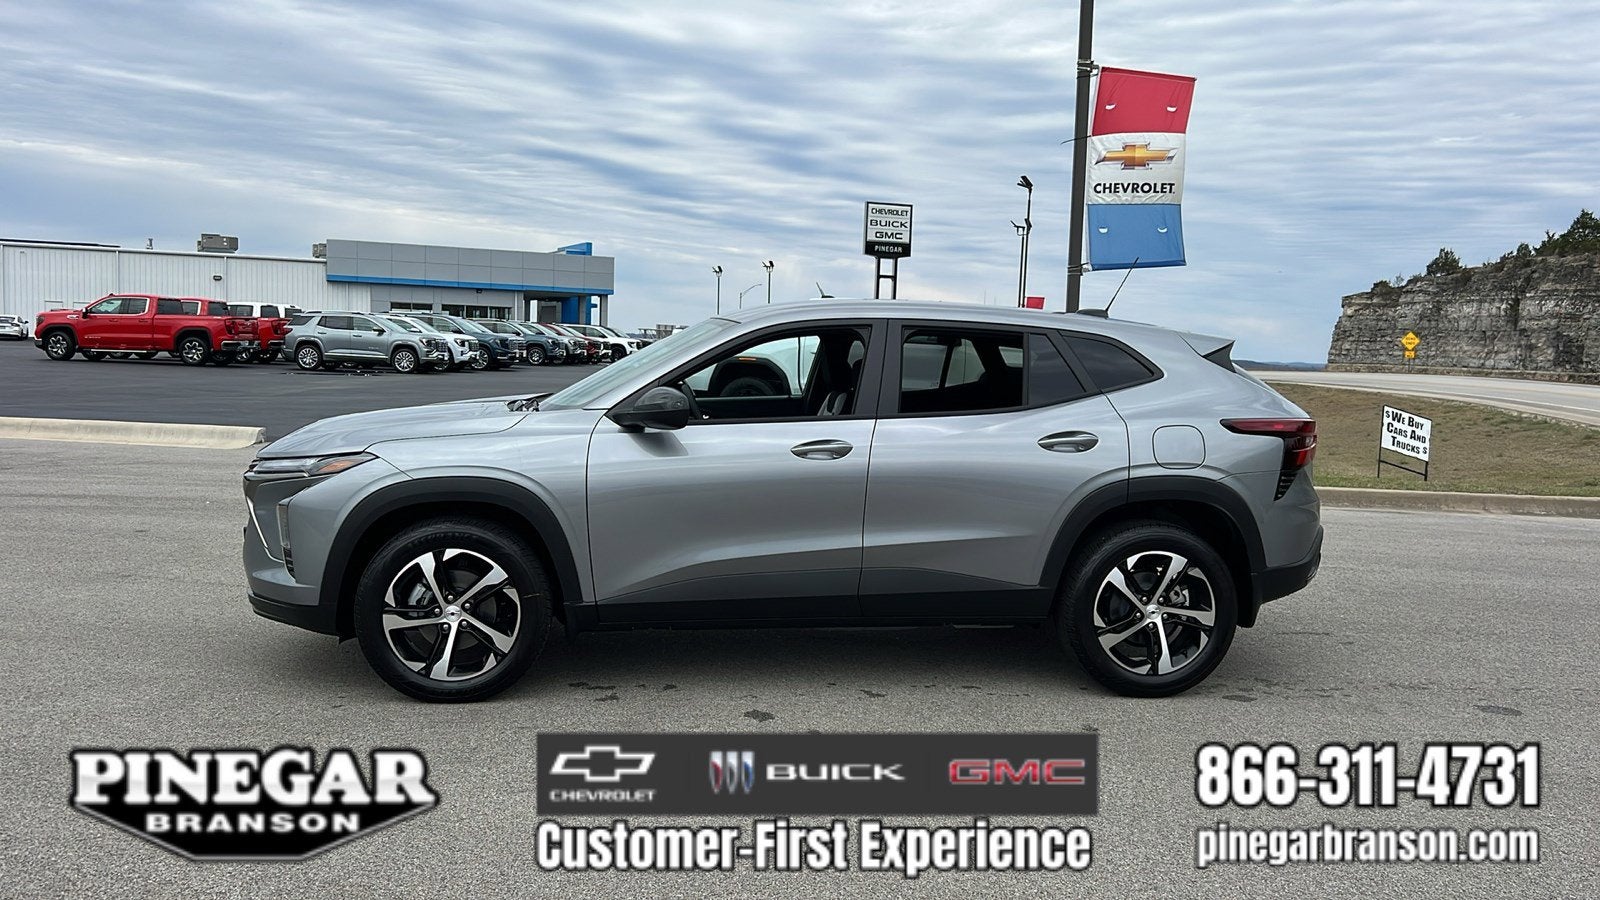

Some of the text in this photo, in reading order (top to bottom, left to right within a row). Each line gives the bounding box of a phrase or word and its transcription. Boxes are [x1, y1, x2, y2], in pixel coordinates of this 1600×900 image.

[1093, 182, 1176, 194] CHEVROLET
[871, 208, 909, 216] CHEVROLET
[870, 219, 908, 228] BUICK
[875, 231, 903, 240] GMC
